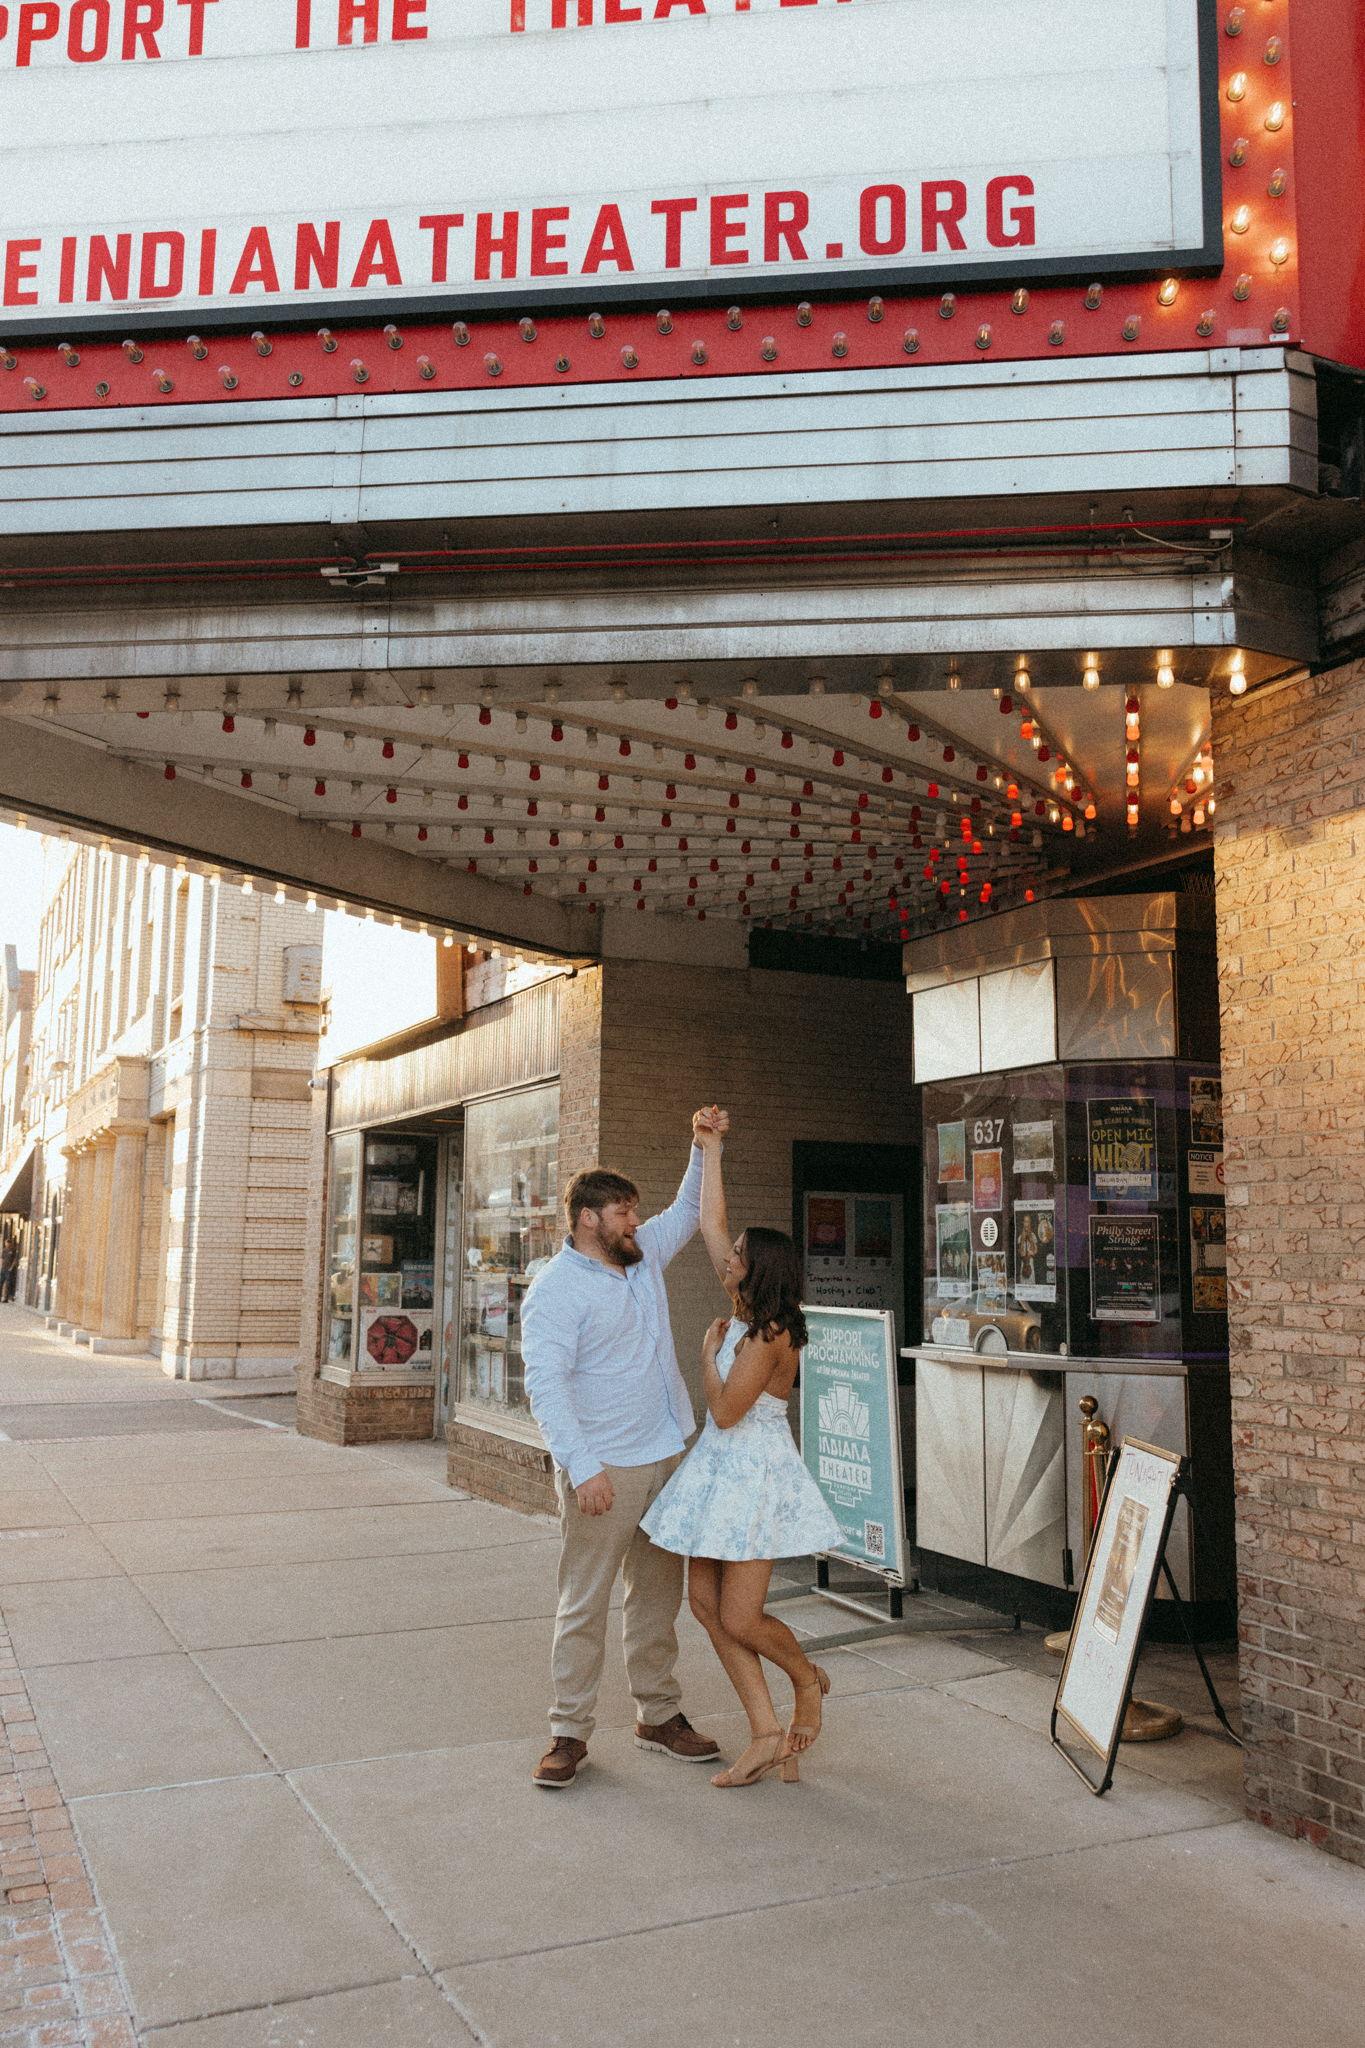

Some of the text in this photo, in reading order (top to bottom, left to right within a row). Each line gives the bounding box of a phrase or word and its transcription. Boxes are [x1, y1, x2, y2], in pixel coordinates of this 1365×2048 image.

[0, 0, 219, 67] PORT
[974, 1119, 1004, 1144] 637
[1091, 1129, 1152, 1142] OPEN MIC
[1190, 1152, 1213, 1161] NOTICE
[1096, 1225, 1152, 1236] Philly Street
[1107, 1235, 1140, 1246] Strings
[816, 1286, 845, 1297] Hosting
[822, 1327, 862, 1347] SUPPORT
[808, 1343, 880, 1369] PROGRAMMING
[818, 1435, 871, 1464] INDIANA
[821, 1459, 868, 1485] THEATER
